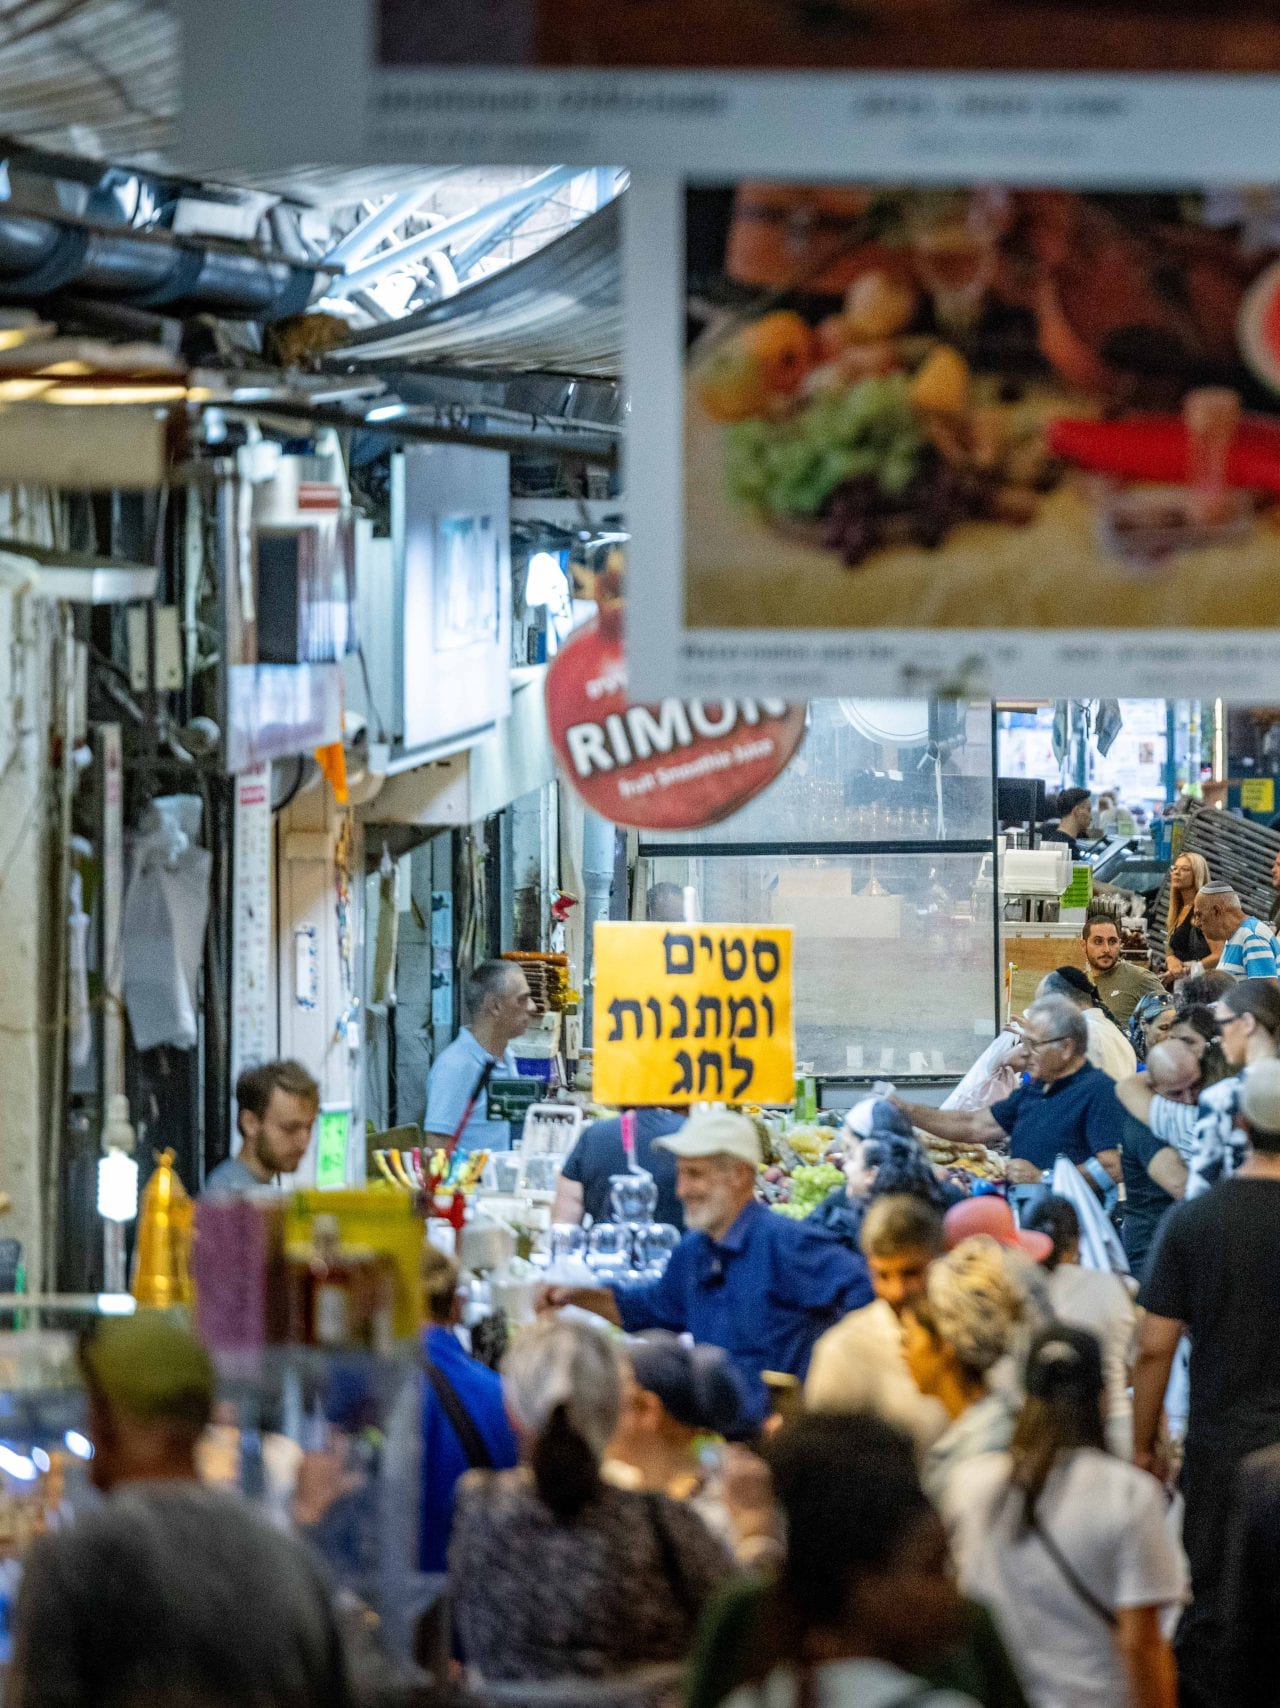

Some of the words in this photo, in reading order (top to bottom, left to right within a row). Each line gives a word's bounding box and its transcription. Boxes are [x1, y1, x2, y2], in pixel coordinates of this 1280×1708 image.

[662, 931, 780, 983] סטים
[607, 993, 774, 1041] ומתנות
[670, 1042, 754, 1099] לחג
